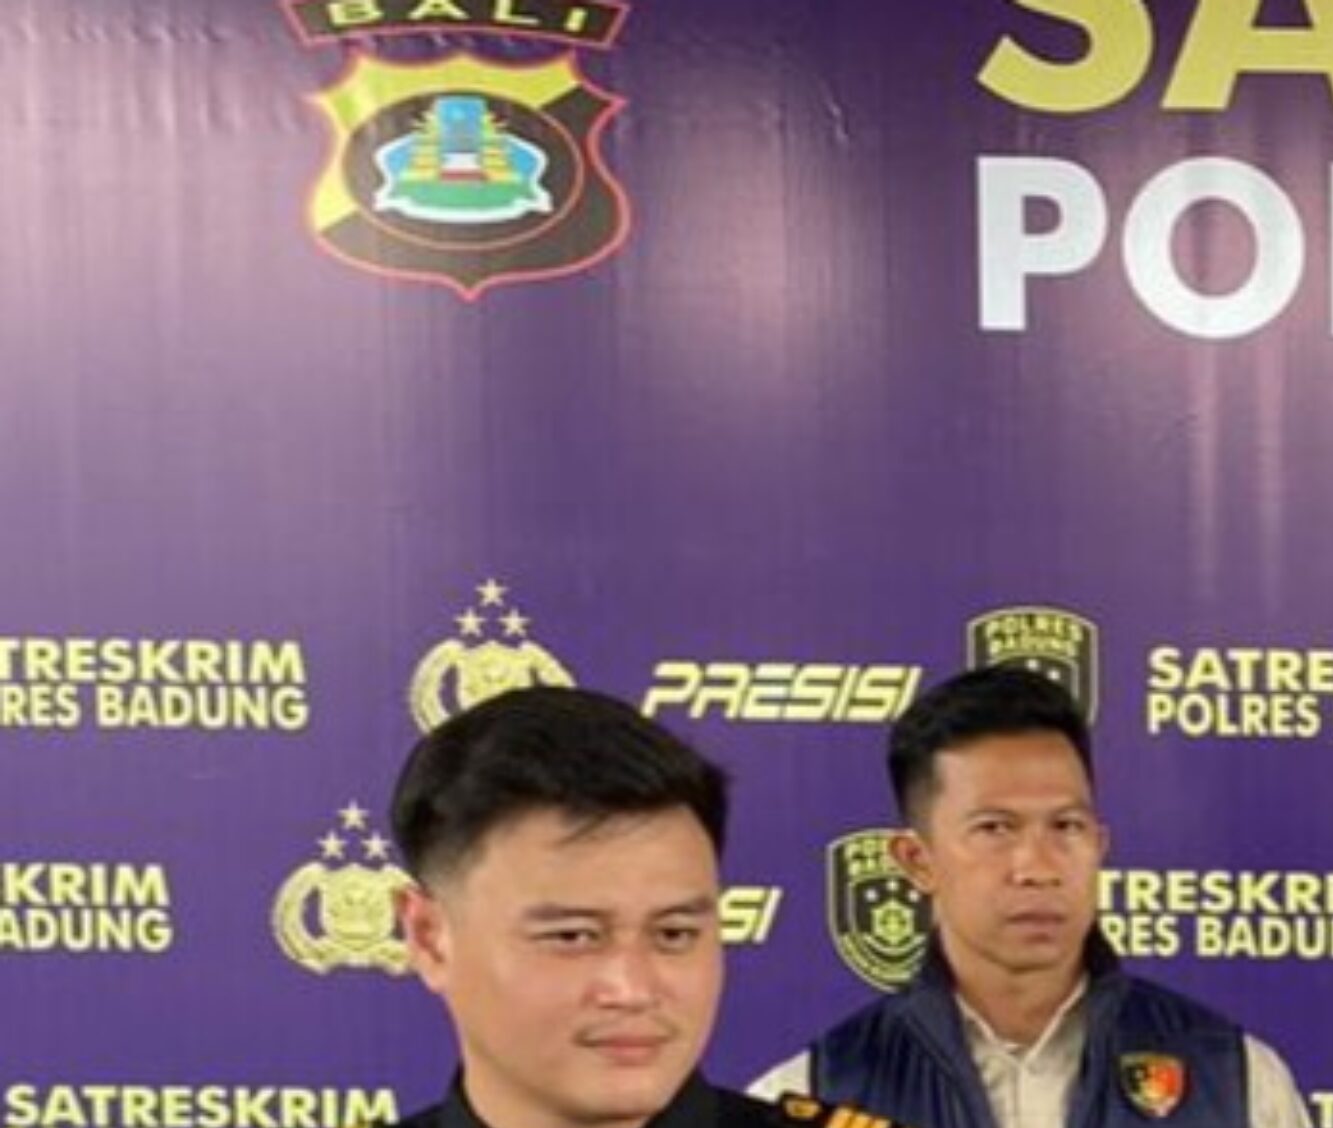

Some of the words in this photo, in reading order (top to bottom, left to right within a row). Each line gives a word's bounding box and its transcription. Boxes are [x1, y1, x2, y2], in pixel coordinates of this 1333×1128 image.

[328, 0, 586, 32] BALI
[0, 637, 306, 684] TRESKRIM
[0, 684, 81, 727] RES
[96, 685, 309, 730] BADUNG
[641, 662, 922, 721] PRESISI
[1147, 694, 1319, 736] POLRES
[0, 908, 173, 952] ADUNG
[1100, 913, 1180, 956] RES
